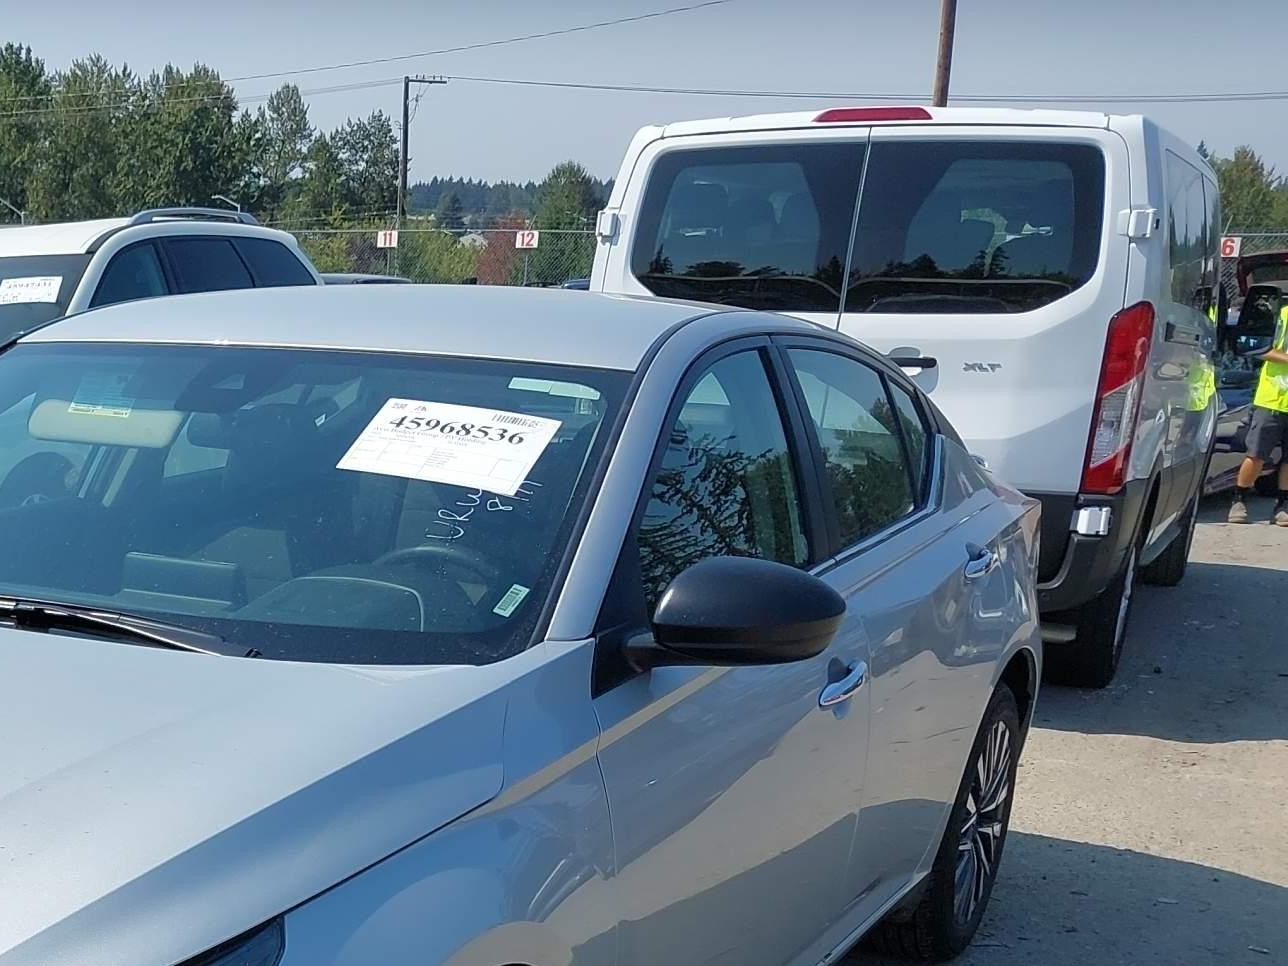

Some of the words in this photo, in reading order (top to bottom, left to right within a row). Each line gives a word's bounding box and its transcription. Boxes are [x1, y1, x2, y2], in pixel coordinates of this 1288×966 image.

[382, 232, 393, 246] 11
[519, 232, 536, 247] 12
[962, 362, 1002, 373] XLT
[389, 415, 526, 445] 45968536
